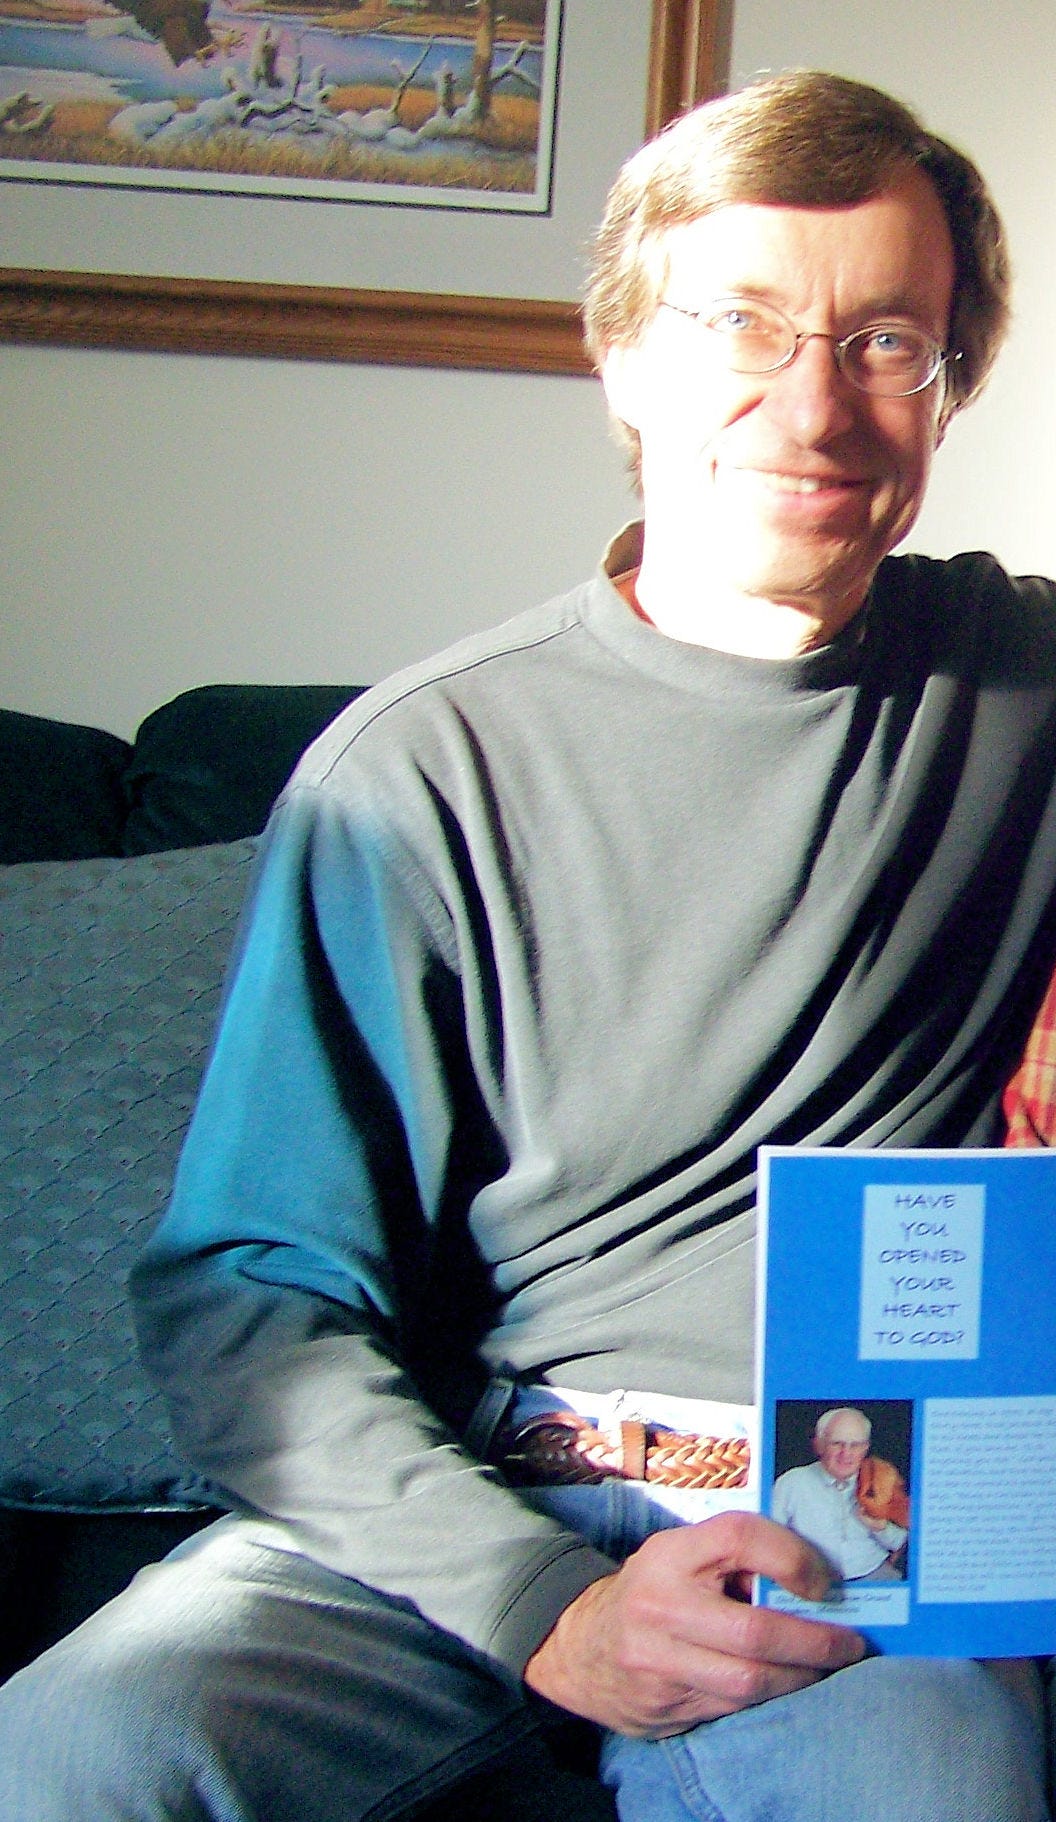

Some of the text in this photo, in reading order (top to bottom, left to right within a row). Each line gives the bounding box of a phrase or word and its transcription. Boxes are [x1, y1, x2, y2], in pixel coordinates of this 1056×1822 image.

[895, 1193, 957, 1209] HAVE
[900, 1221, 949, 1242] YOU
[878, 1249, 968, 1264] OPENED
[890, 1275, 957, 1297] YOUR
[882, 1303, 962, 1318] HEART
[874, 1330, 966, 1349] TO GOD?
